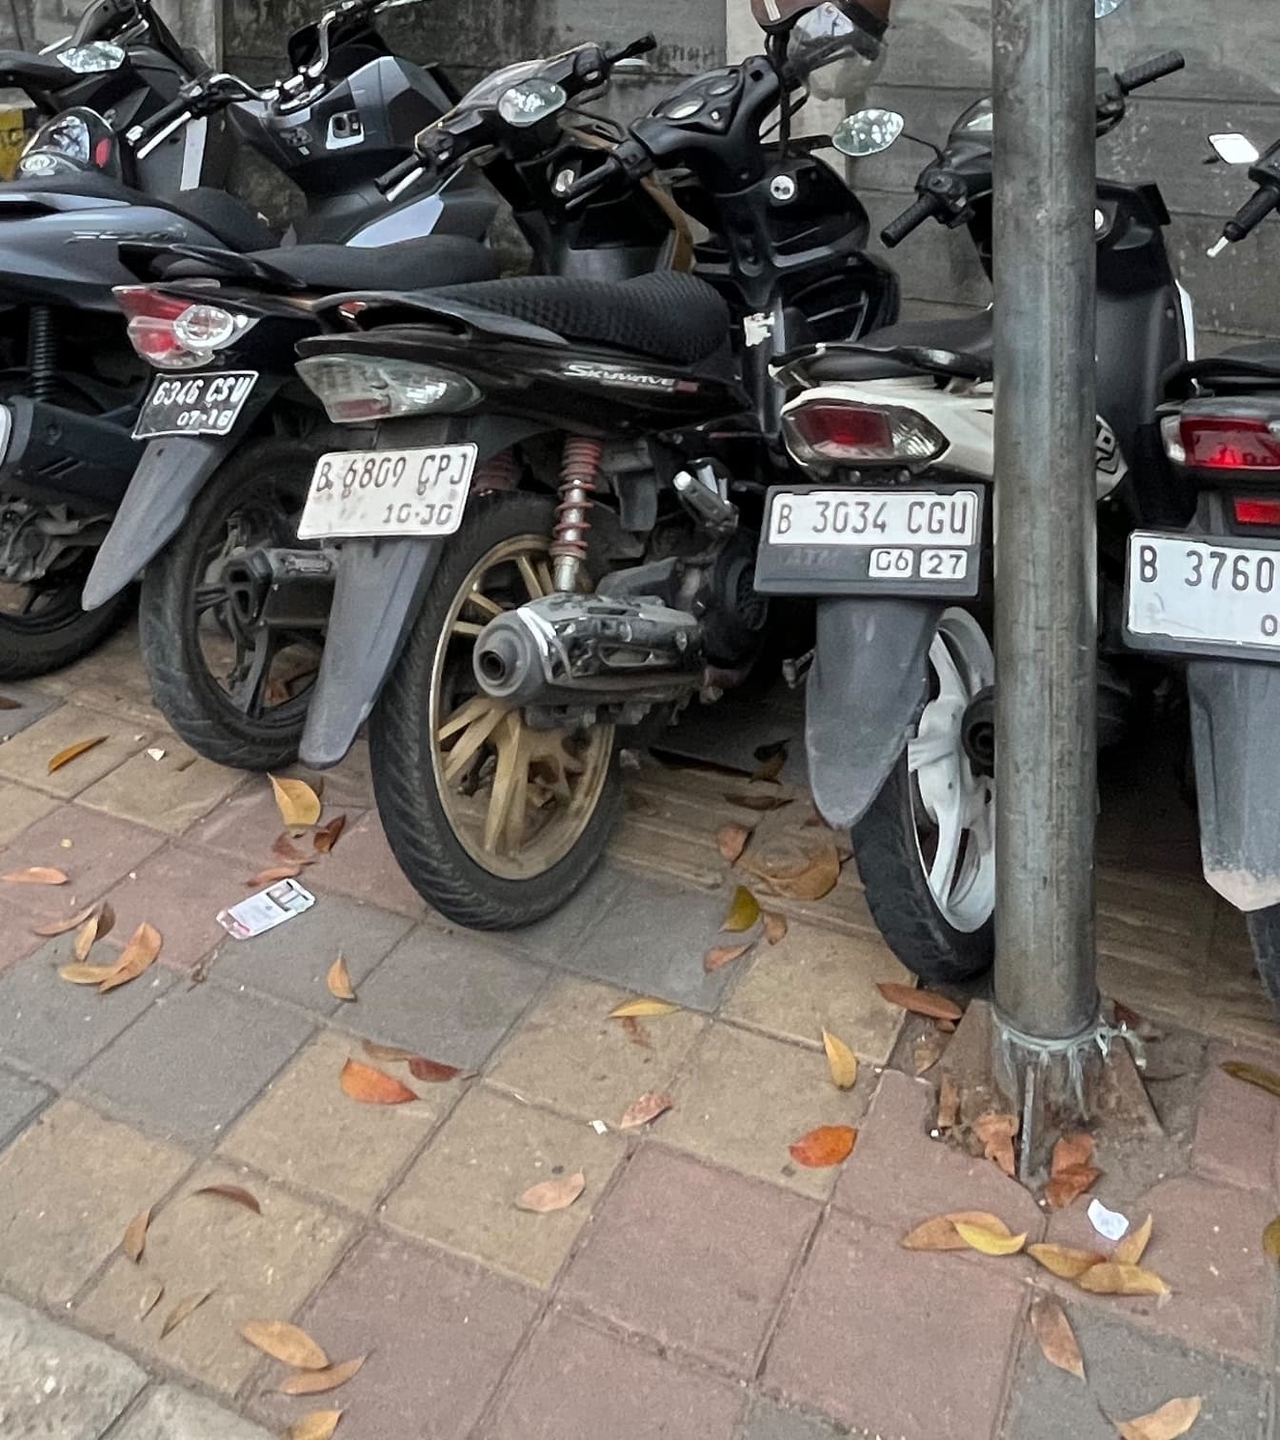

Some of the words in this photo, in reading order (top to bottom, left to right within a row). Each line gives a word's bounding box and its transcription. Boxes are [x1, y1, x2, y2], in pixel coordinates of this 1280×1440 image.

[315, 461, 333, 493] B
[340, 456, 407, 490] 6809
[418, 453, 468, 488] CPJ
[776, 503, 793, 535] B
[812, 500, 888, 534] 3034
[906, 500, 969, 535] CGU
[926, 553, 964, 575] 27
[1139, 544, 1159, 583] B
[1184, 550, 1276, 594] 3760
